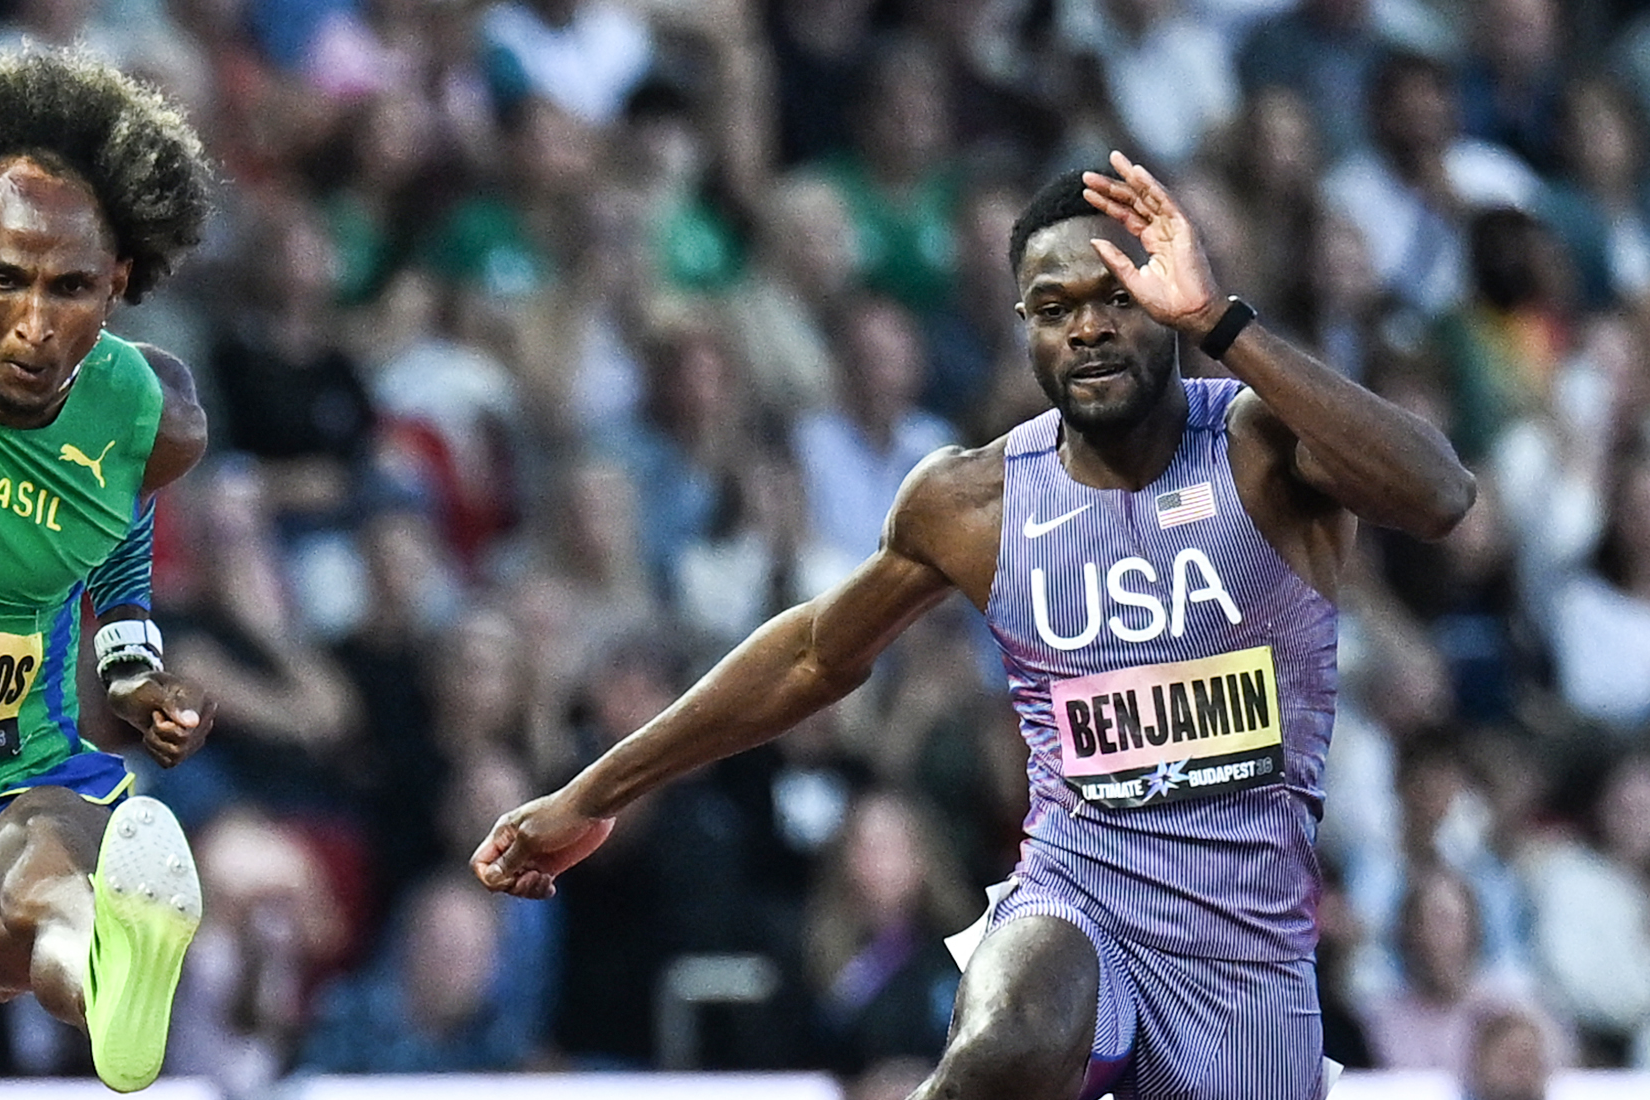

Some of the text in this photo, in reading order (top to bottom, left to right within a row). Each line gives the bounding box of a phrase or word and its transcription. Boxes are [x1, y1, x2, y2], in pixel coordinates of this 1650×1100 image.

[1031, 547, 1242, 650] USA
[1065, 668, 1270, 760] BENJAMIN
[1081, 779, 1144, 800] ULTIMATE
